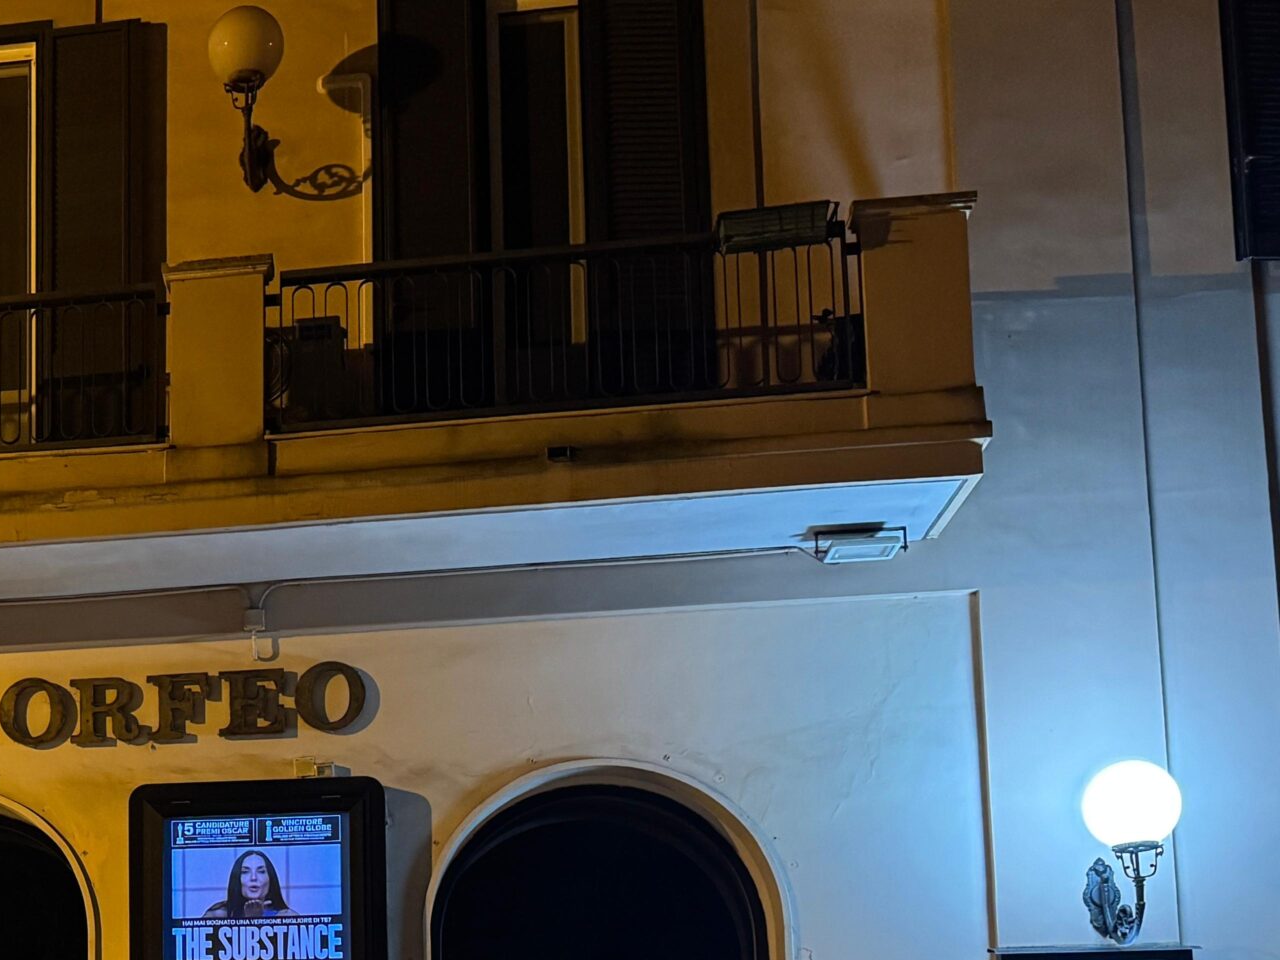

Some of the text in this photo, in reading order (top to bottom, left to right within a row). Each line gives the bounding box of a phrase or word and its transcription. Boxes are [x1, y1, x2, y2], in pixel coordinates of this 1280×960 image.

[281, 818, 323, 826] VINCITORE
[184, 821, 250, 835] 5 CANDIDATURE
[221, 826, 249, 834] OSCAR
[272, 825, 305, 833] GOLDEN
